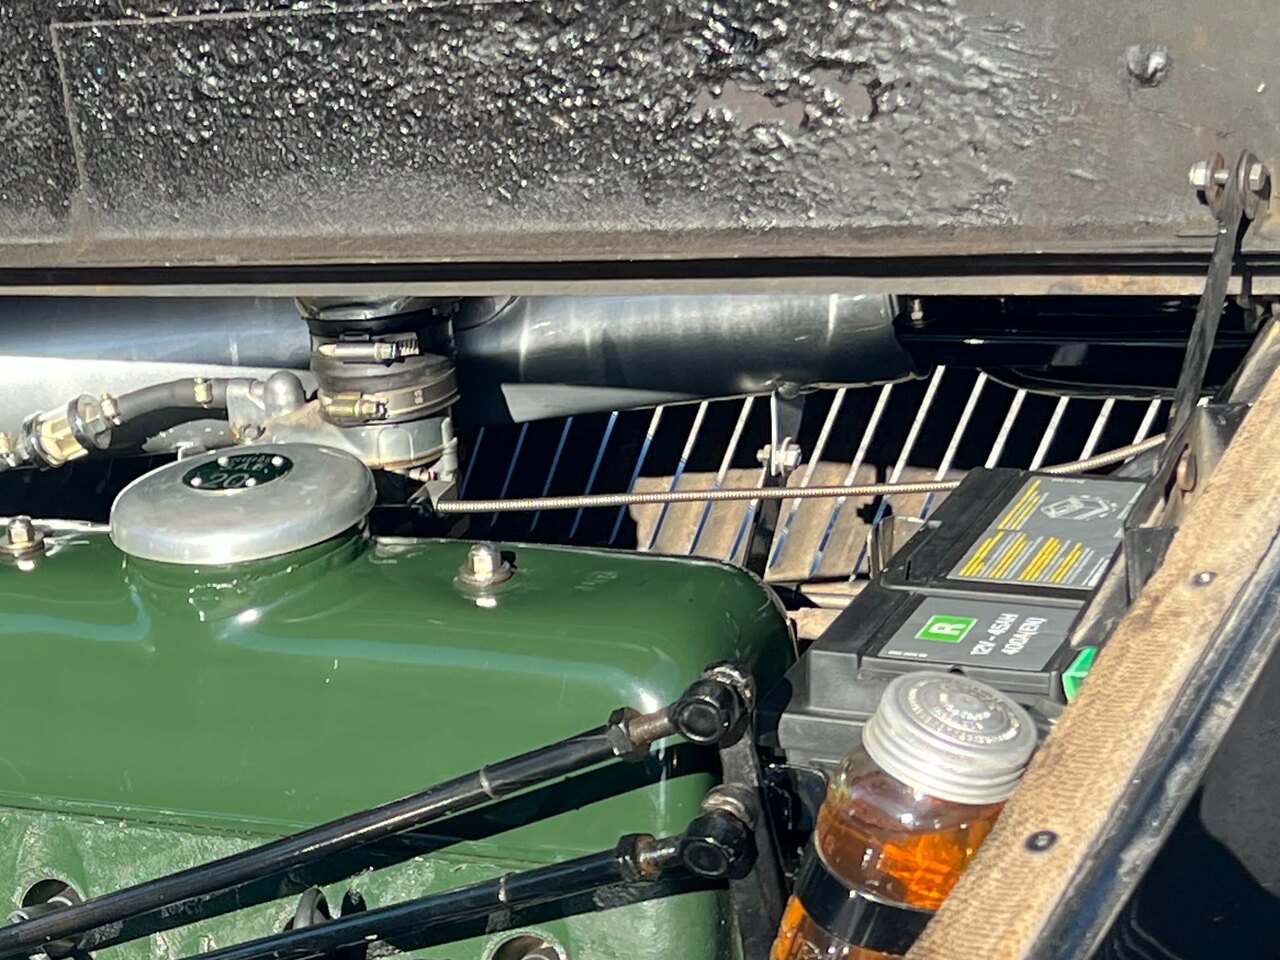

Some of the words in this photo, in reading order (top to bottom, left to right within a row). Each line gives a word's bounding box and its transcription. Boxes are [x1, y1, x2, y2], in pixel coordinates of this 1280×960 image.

[199, 472, 250, 489] 20
[928, 622, 968, 636] R
[970, 640, 997, 655] 12V
